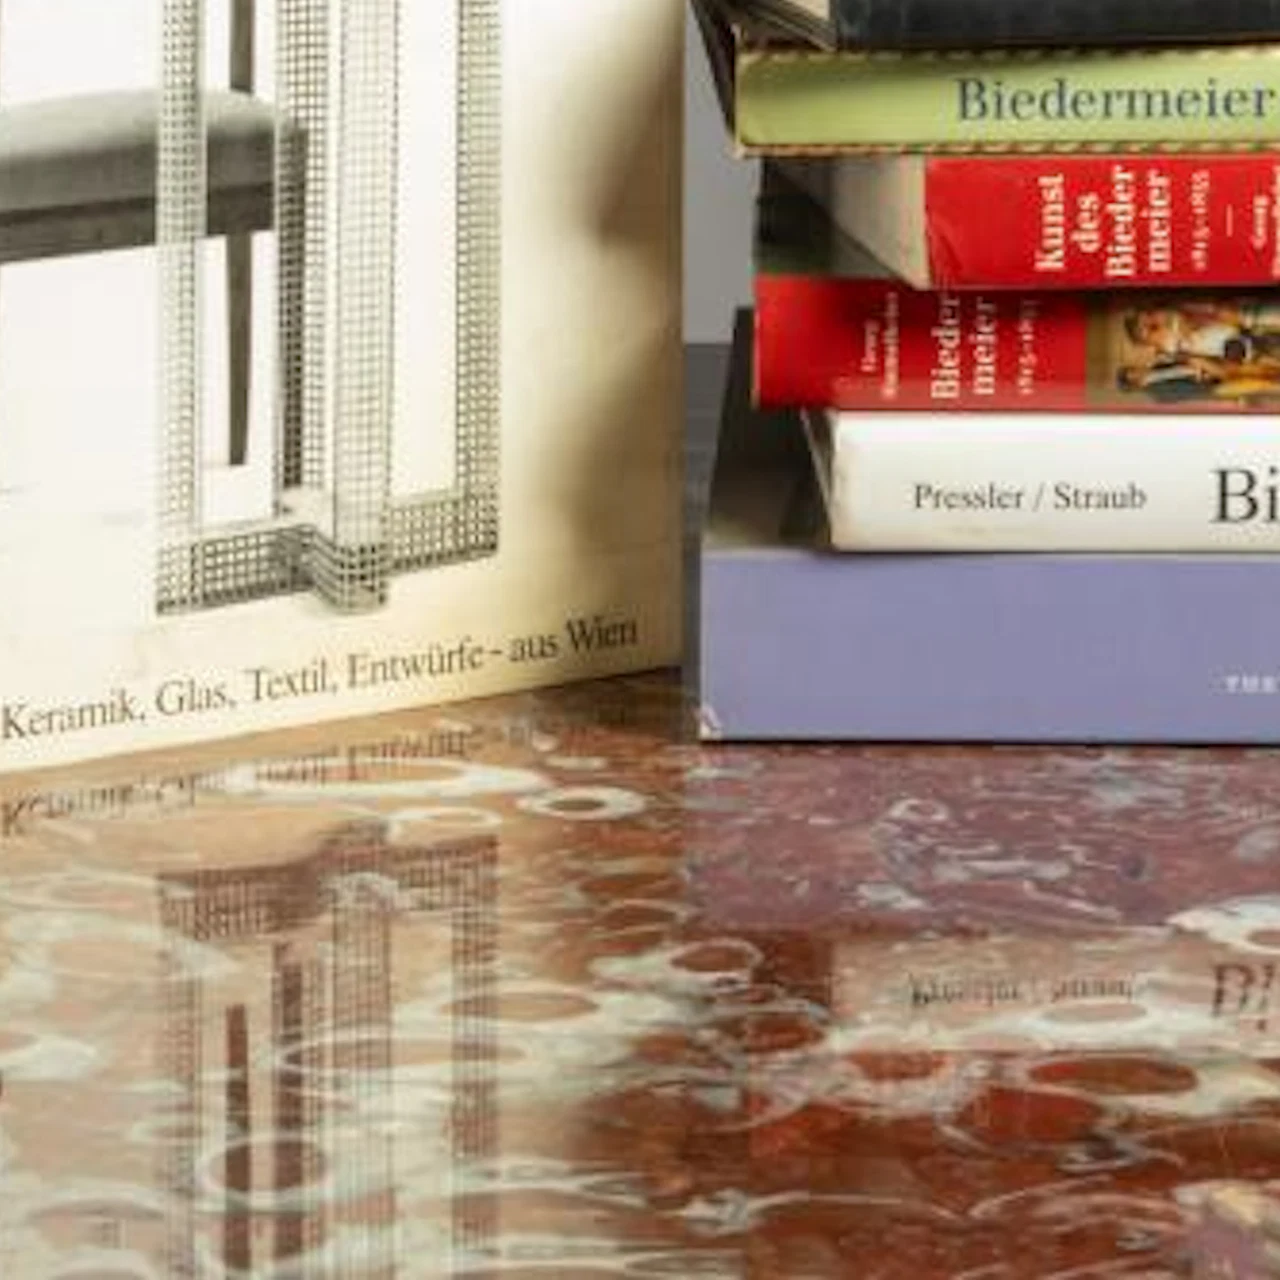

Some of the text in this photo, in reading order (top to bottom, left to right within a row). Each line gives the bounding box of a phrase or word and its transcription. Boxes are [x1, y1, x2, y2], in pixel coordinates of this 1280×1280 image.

[956, 75, 1278, 122] Biedermeier
[1034, 173, 1066, 271] Kunst
[1070, 192, 1101, 253] des
[1105, 164, 1136, 277] Bieder
[1140, 168, 1172, 272] meier
[928, 297, 963, 401] Bieder
[968, 295, 999, 398] meier
[913, 483, 1025, 511] Pressler
[1053, 483, 1148, 511] Straub
[0, 687, 147, 742] Keramik,
[153, 677, 238, 718] Glas,
[244, 657, 339, 703] Textil,
[506, 631, 560, 665] aus
[566, 611, 639, 654] Wien
[1225, 674, 1277, 694] THE
